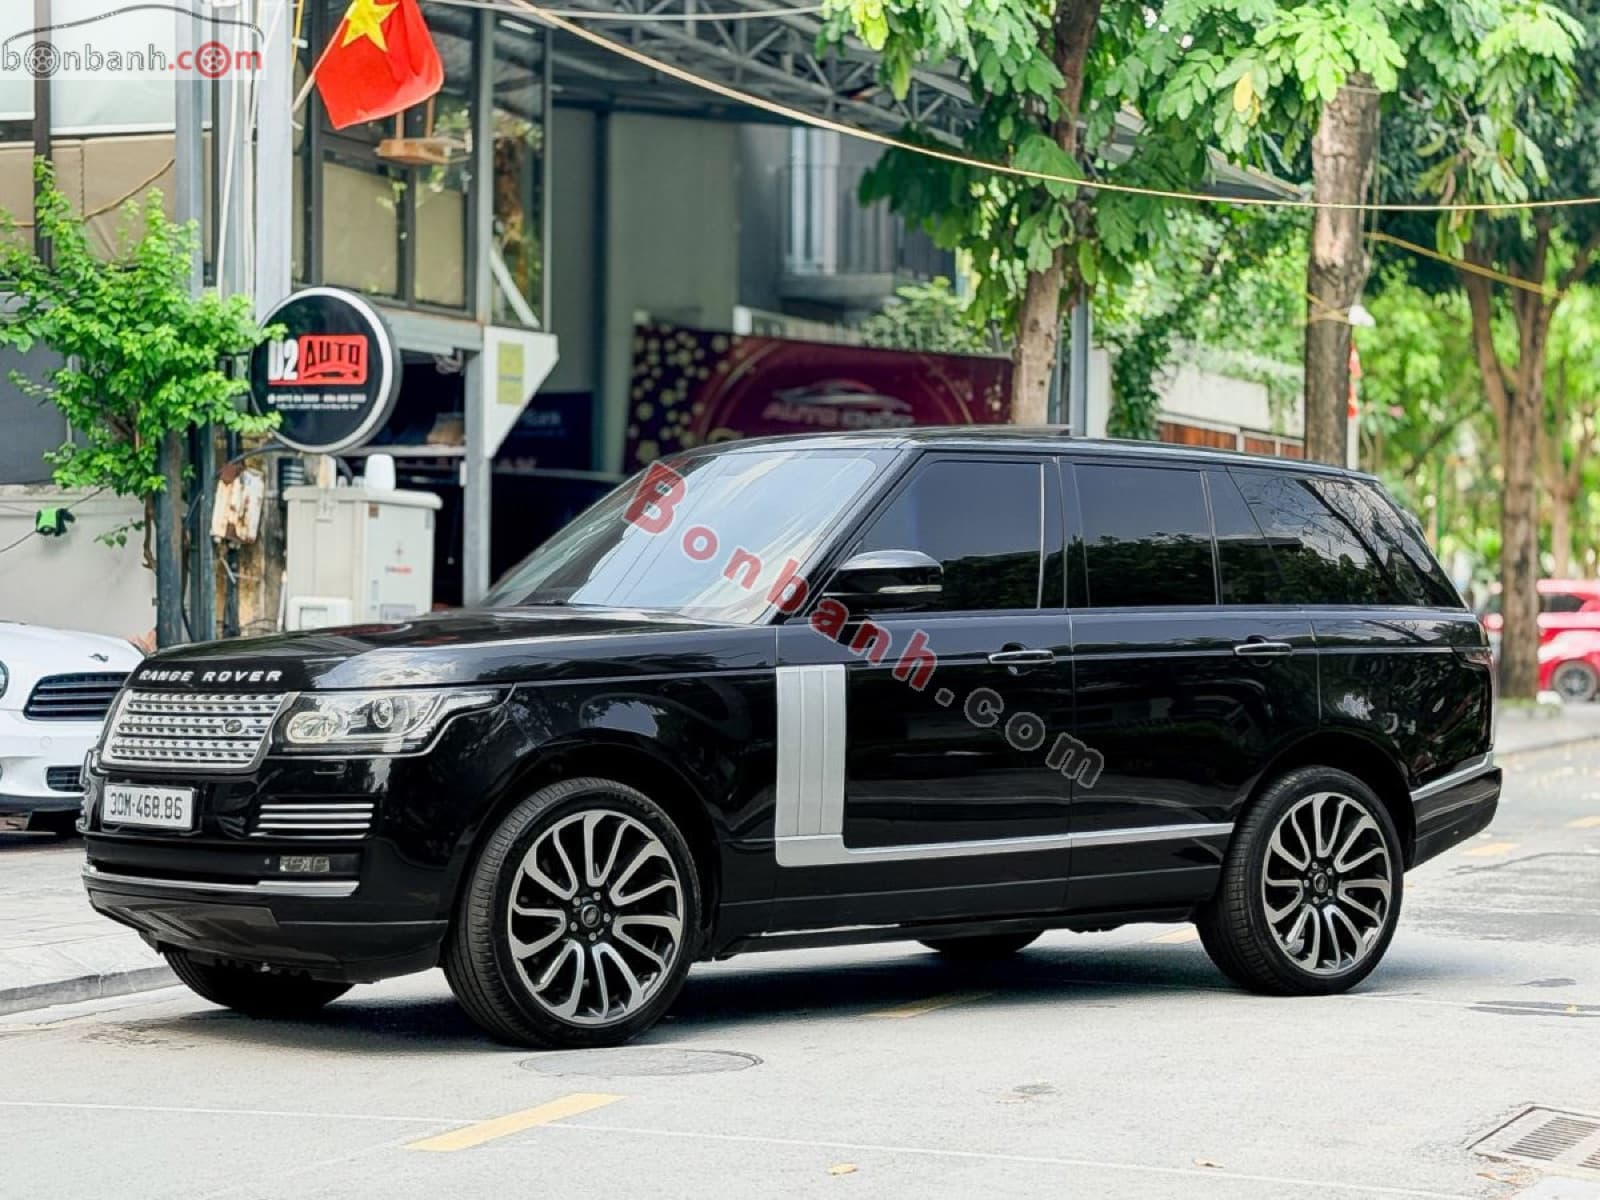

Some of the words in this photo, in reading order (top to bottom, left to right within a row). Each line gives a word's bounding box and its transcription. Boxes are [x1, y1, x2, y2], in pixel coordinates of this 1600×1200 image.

[303, 339, 361, 373] AUTO
[138, 669, 195, 682] RANGE
[202, 670, 283, 682] ROVER
